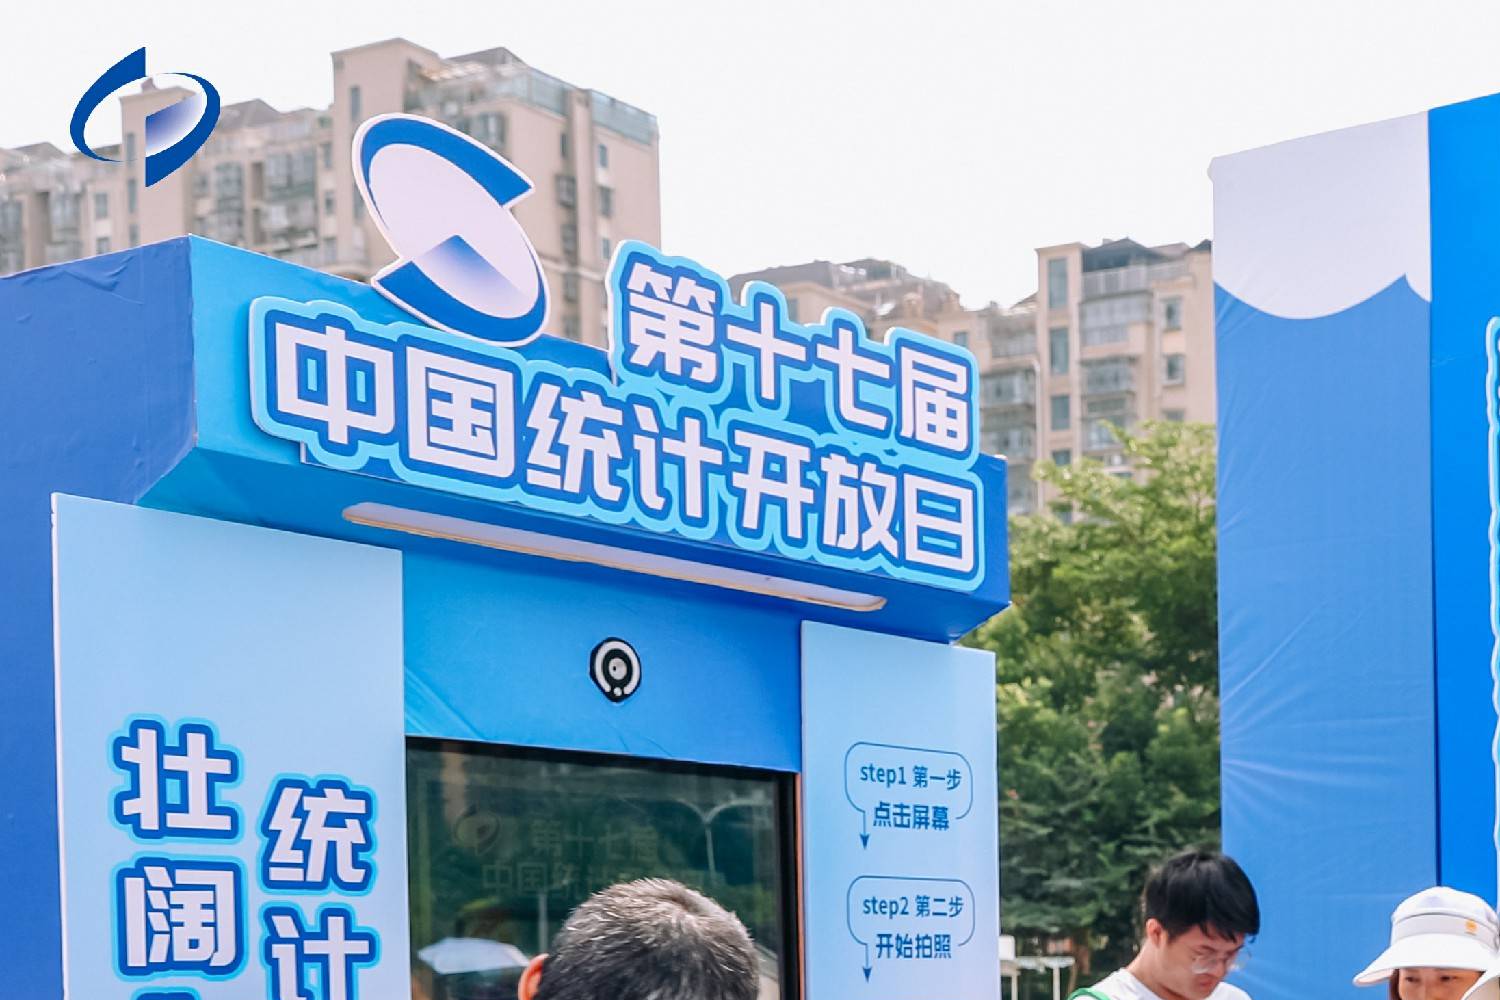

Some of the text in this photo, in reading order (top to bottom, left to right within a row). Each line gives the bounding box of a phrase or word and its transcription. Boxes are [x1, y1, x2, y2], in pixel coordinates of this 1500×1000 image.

[627, 262, 968, 453] 第十七届
[274, 320, 977, 573] 中国统计开放日
[860, 763, 962, 790] step1 第一步
[873, 802, 950, 831] 点击屏幕
[863, 895, 964, 919] step2 第二步
[875, 933, 952, 960] 开始拍照
